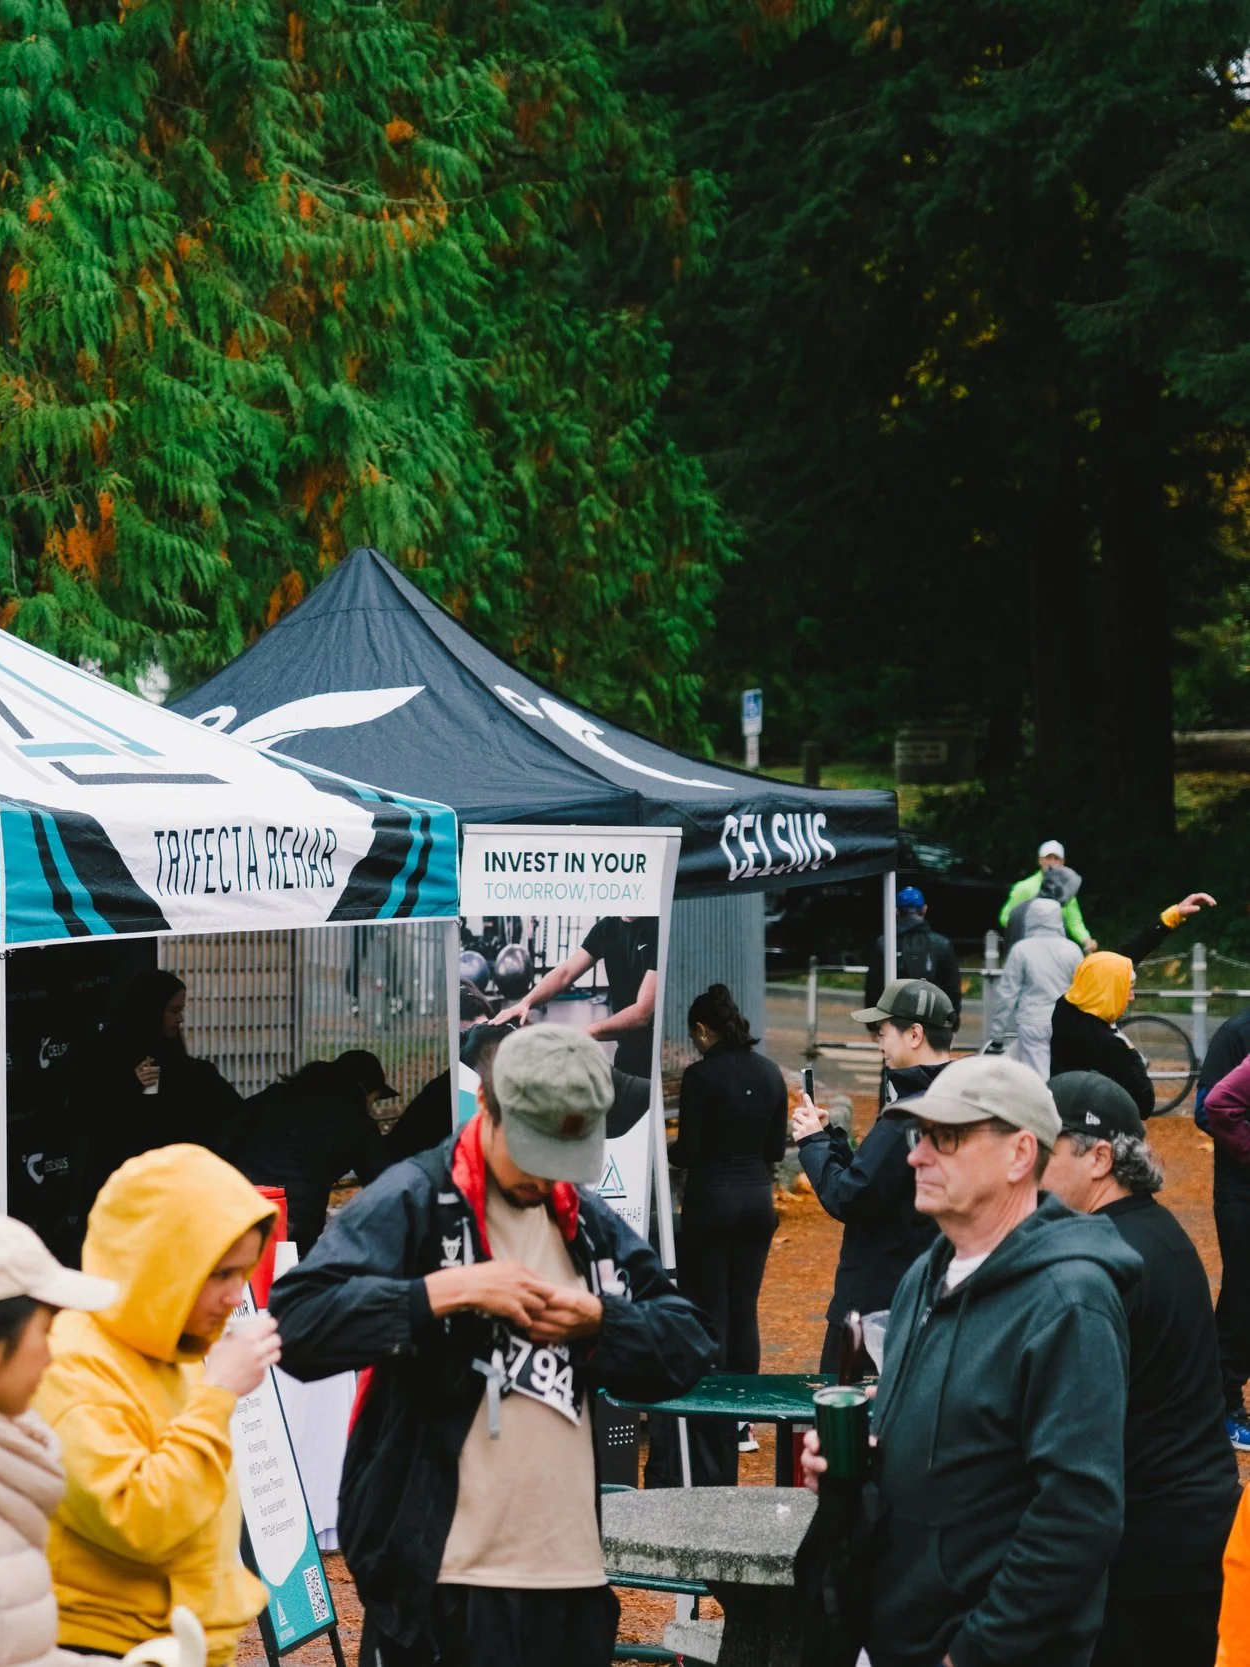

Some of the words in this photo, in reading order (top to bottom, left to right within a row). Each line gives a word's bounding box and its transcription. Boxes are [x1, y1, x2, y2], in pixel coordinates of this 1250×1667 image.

[153, 826, 261, 897] TRIFECTA
[265, 826, 337, 891] REHAB
[484, 851, 559, 873] INVEST
[564, 852, 585, 873] IN
[591, 852, 647, 874] YOUR
[719, 812, 837, 882] CELSIUS
